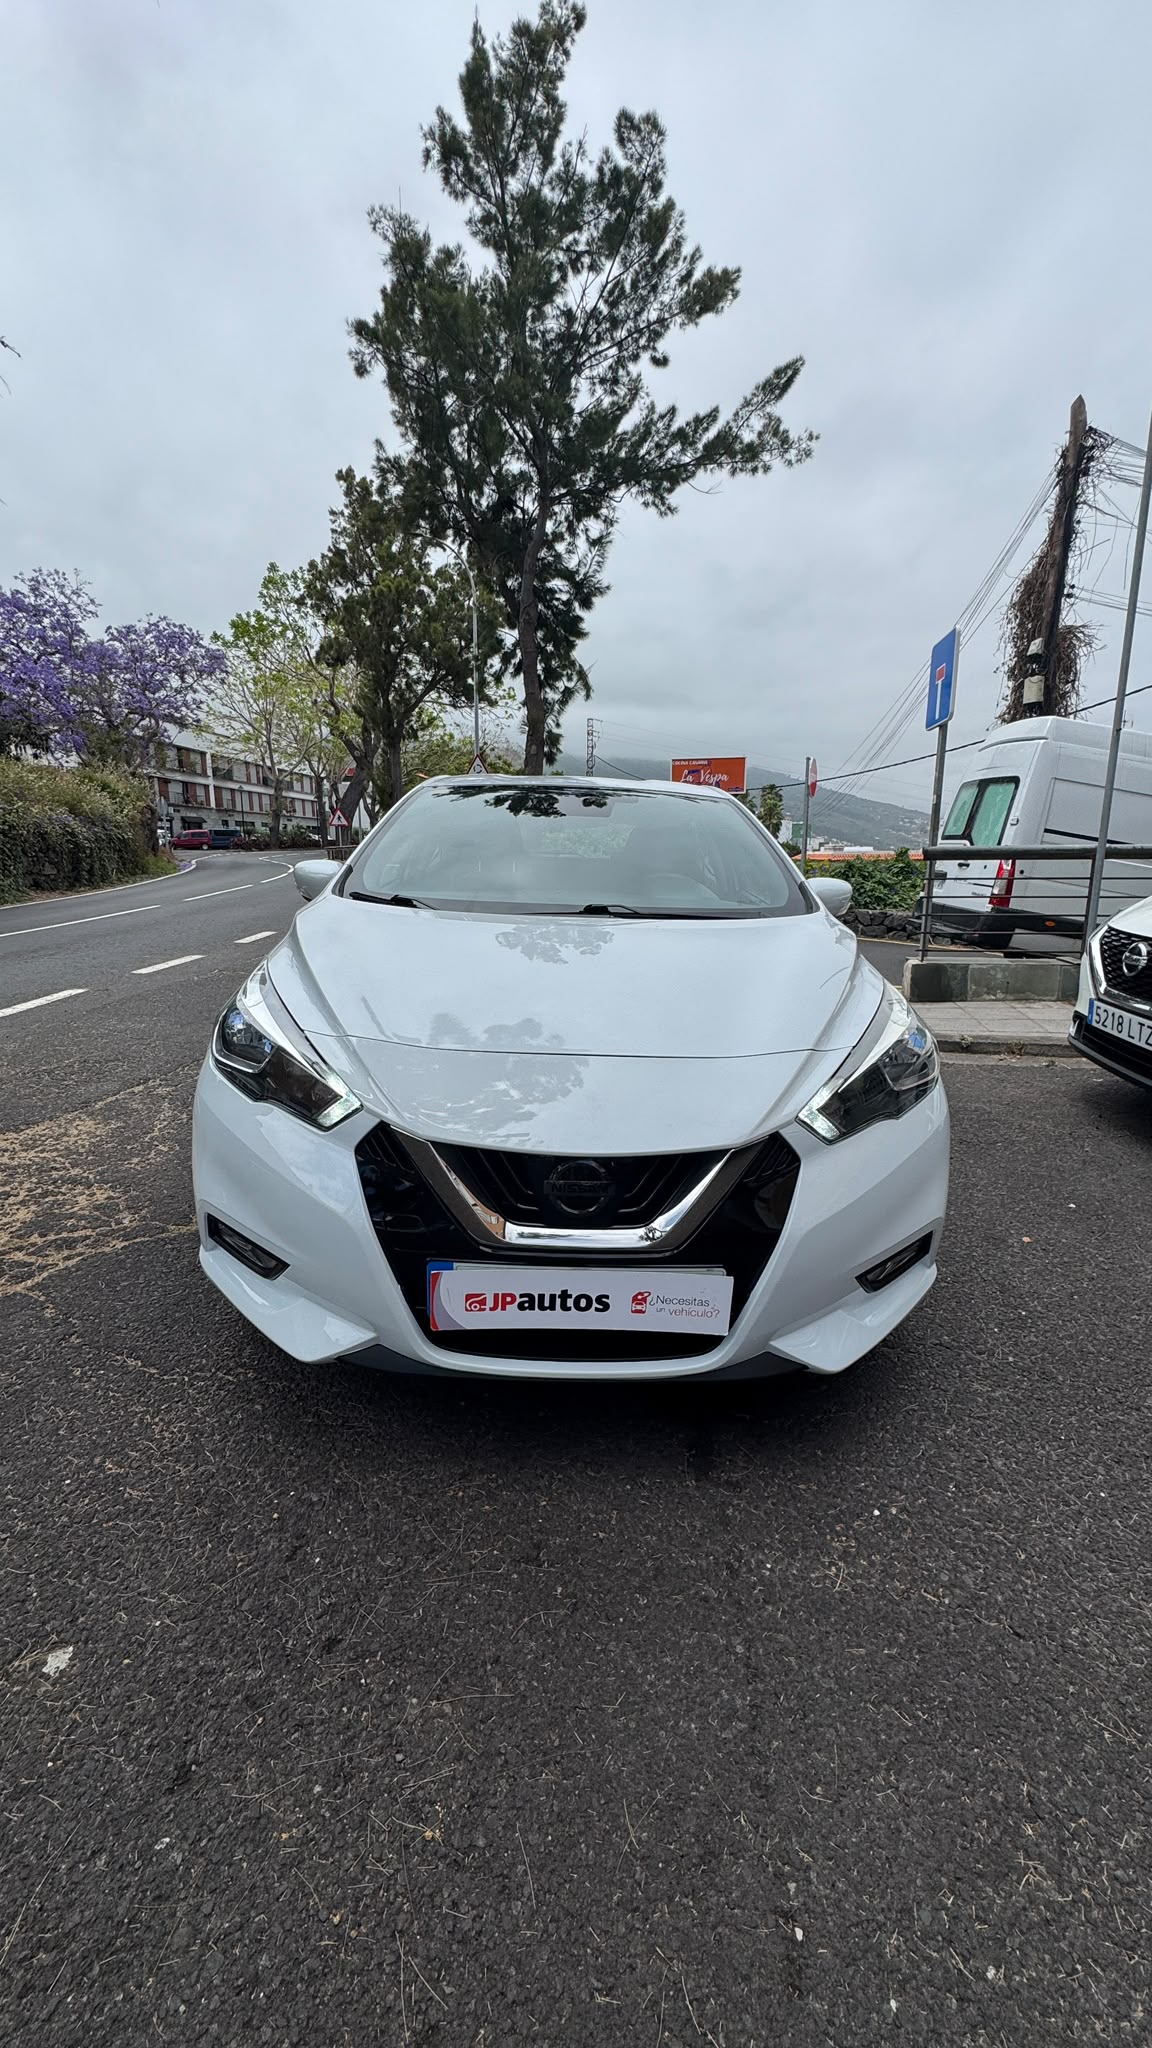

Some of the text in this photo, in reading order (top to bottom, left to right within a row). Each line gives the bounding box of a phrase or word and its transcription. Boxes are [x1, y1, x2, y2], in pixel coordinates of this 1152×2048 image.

[681, 769, 729, 786] La Vespa
[1095, 1006, 1124, 1034] 5218
[489, 1289, 611, 1313] JPautos
[648, 1295, 711, 1308] ¿Necesitas
[668, 1307, 721, 1319] vehículo?
